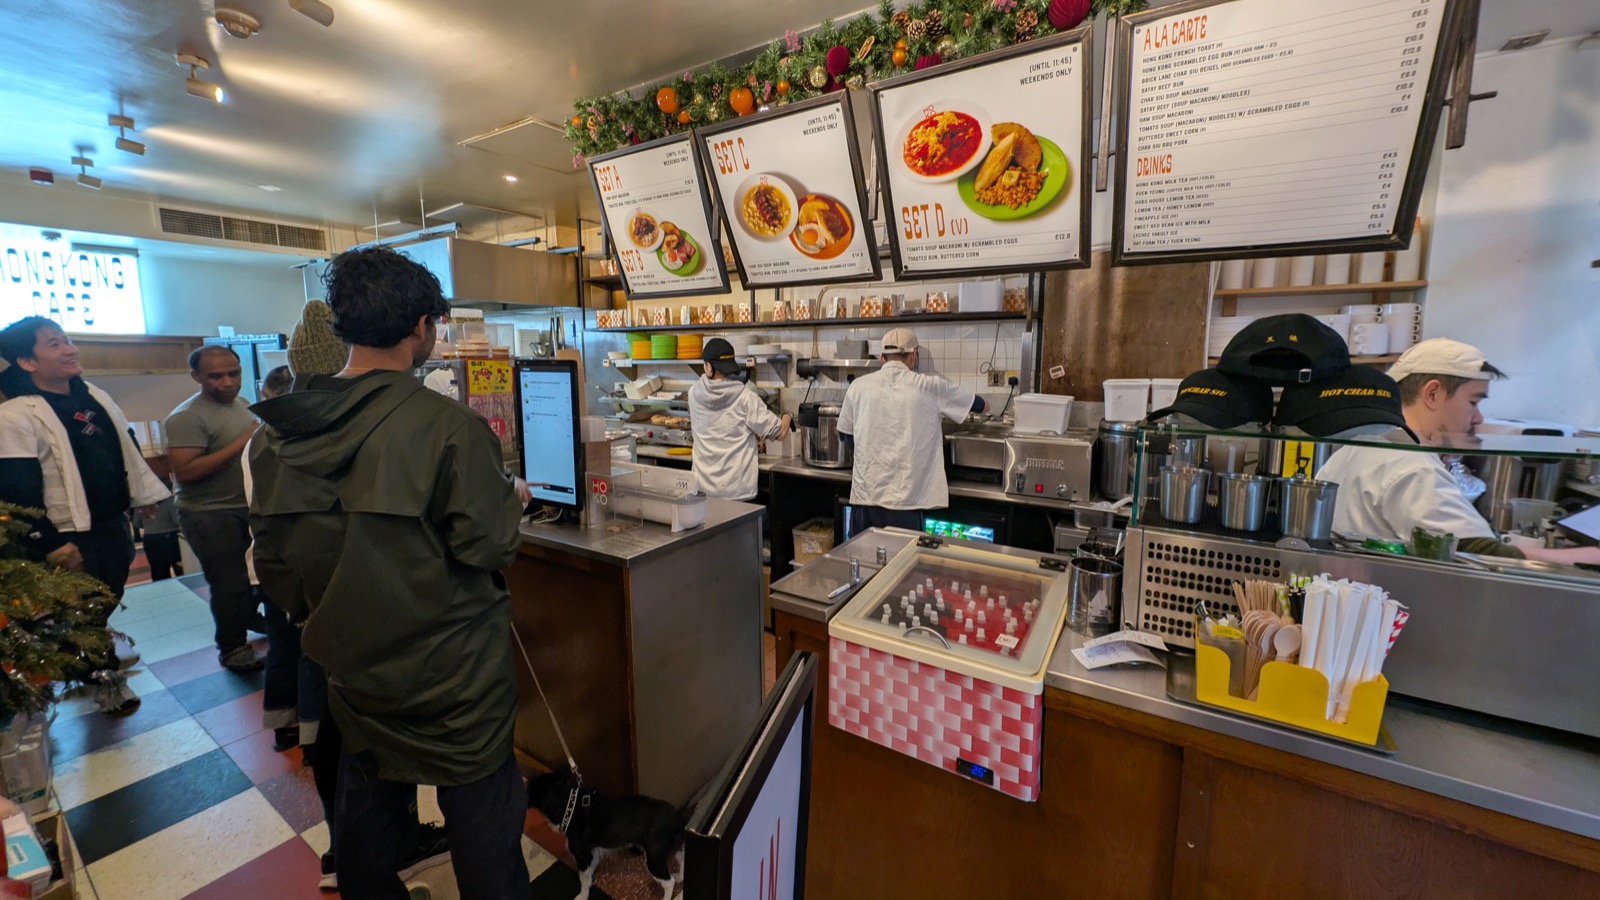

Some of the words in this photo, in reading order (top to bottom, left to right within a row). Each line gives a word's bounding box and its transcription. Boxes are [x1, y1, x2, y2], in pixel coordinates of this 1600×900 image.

[1144, 28, 1151, 52] A
[1155, 24, 1168, 48] LA
[1172, 15, 1208, 44] CARTE
[1143, 56, 1157, 64] HONG
[1174, 48, 1196, 57] FRENCH
[1197, 44, 1215, 52] TOAST
[1030, 61, 1050, 72] (UNTIL
[1053, 56, 1071, 67] 11:45)
[1142, 66, 1156, 74] HONG
[1158, 63, 1172, 71] KONG
[1173, 56, 1206, 68] SCRAMBLED
[1208, 53, 1219, 61] EGG
[1142, 76, 1157, 84] BRICK
[1173, 70, 1187, 78] CHAR
[1200, 64, 1219, 73] BEIGEL
[1233, 56, 1260, 66] SCRAMBLED
[1020, 72, 1053, 85] WEEKENDS
[1056, 68, 1072, 77] ONLY
[1158, 83, 1171, 91] BEEF
[1181, 87, 1209, 96] MACARONI
[1157, 103, 1170, 111] BEEF
[1171, 100, 1188, 108] (SOUP
[1221, 90, 1250, 100] NOODLES)
[807, 117, 822, 126] (UNTIL
[1167, 110, 1193, 118] MACARONI
[1176, 117, 1207, 127] (MACARONI/
[1209, 112, 1237, 122] NOODLES)
[1247, 105, 1283, 115] SCRAMBLED
[1284, 102, 1301, 110] EGGS
[803, 125, 826, 136] WEEKENDS
[1138, 133, 1164, 142] BUTTERED
[1166, 130, 1183, 138] SWEET
[663, 158, 680, 167] WEEKENDS
[714, 139, 738, 176] SET
[738, 136, 750, 174] C
[1136, 154, 1172, 177] DRINKS
[598, 166, 616, 192] SET
[612, 164, 622, 190] A
[902, 204, 930, 240] SET
[936, 202, 946, 237] D
[950, 218, 969, 236] (V)
[621, 249, 638, 272] SET
[60, 252, 124, 289] KONG
[1210, 388, 1228, 397] SIU
[1320, 388, 1344, 398] HOT
[1344, 388, 1376, 396] CHAR
[592, 480, 608, 493] HO
[594, 494, 608, 505] KO
